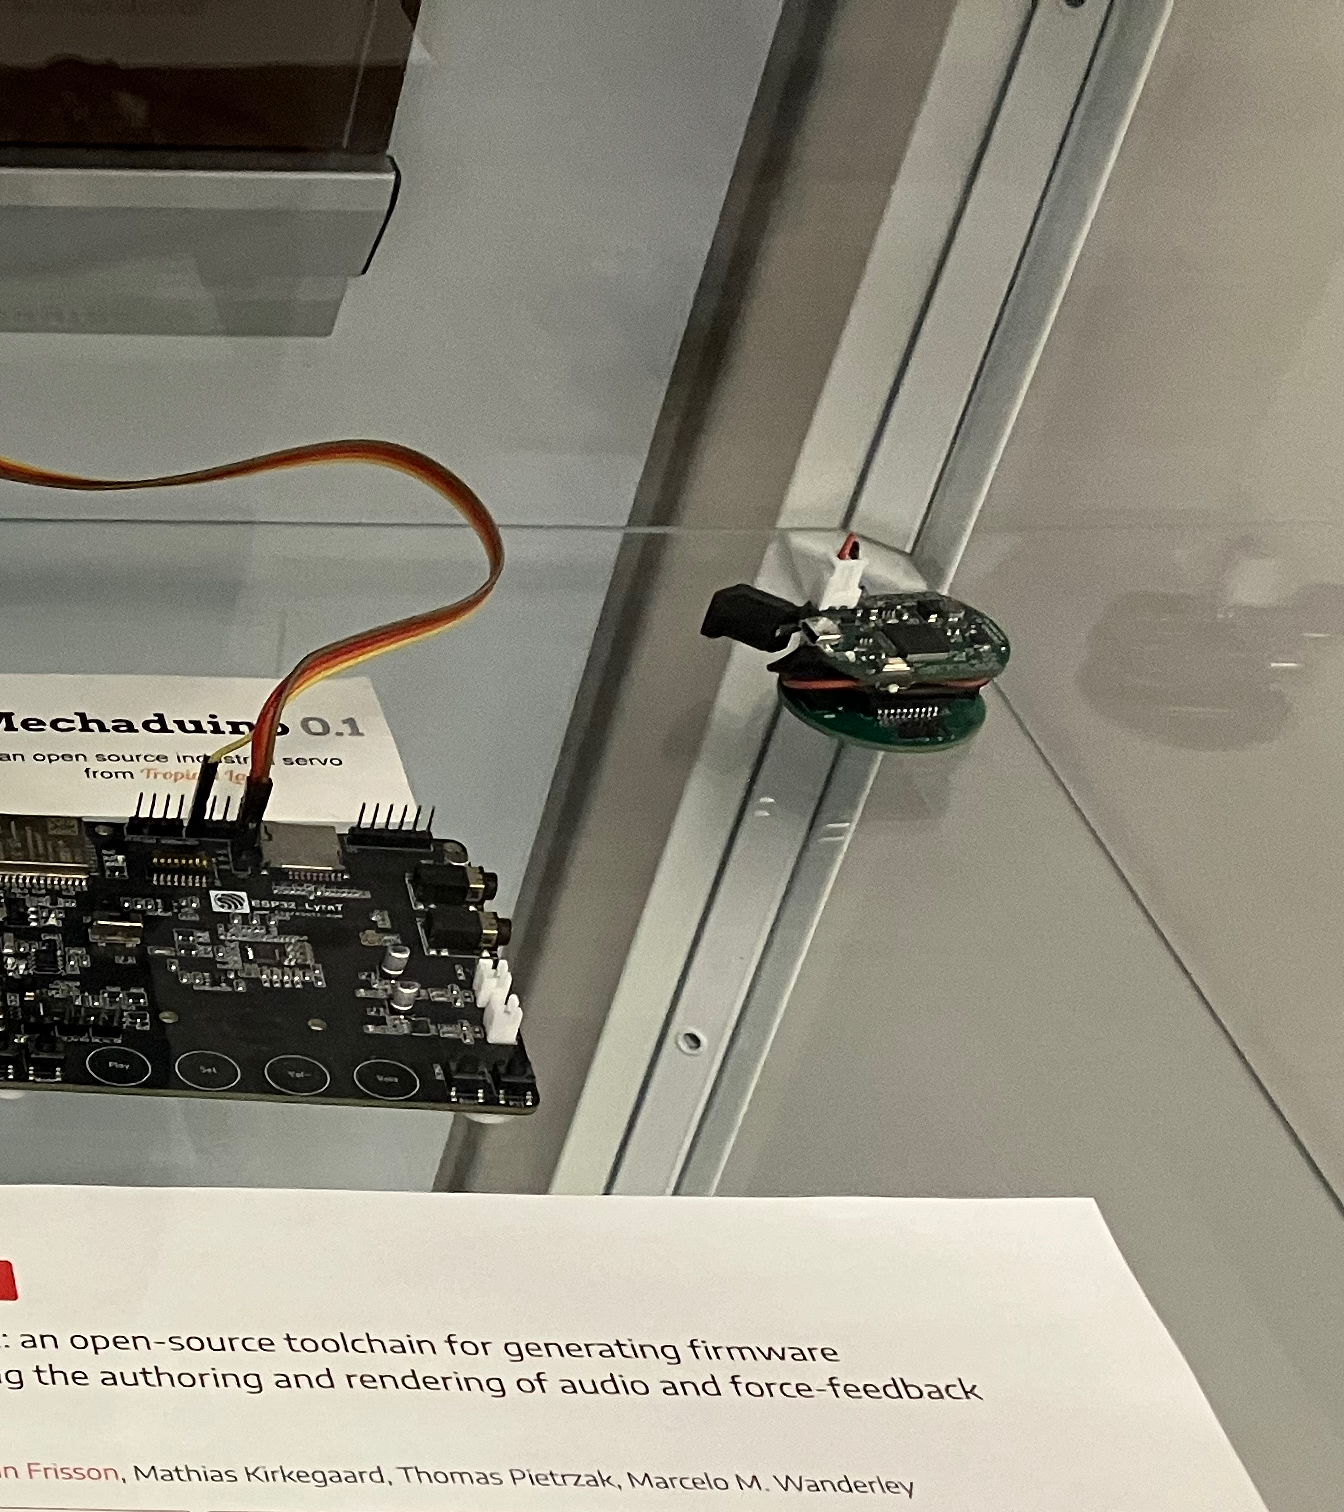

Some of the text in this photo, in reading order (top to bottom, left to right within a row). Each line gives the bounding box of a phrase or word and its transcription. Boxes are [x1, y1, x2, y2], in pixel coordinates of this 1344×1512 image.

[300, 717, 365, 737] 0.1
[0, 750, 25, 763] an
[33, 752, 87, 765] open
[96, 751, 169, 764] source
[283, 755, 343, 767] servo
[85, 768, 134, 780] from
[20, 1332, 58, 1350] an
[70, 1332, 275, 1355] open-source
[283, 1332, 437, 1357] toolchain
[445, 1334, 492, 1357] for
[504, 1338, 682, 1365] generating
[688, 1338, 839, 1363] firmware
[33, 1364, 89, 1386] the
[100, 1367, 263, 1394] authoring
[274, 1367, 334, 1390] and
[345, 1368, 507, 1398] rendering
[516, 1372, 547, 1395] of
[561, 1374, 650, 1397] audio
[661, 1375, 722, 1398] and
[729, 1375, 983, 1401] force-feedback
[26, 1461, 127, 1486] Frisson,
[134, 1464, 238, 1484] Mathias
[245, 1465, 392, 1488] Kirkegaard,
[398, 1466, 503, 1486] Thomas
[510, 1468, 622, 1491] Pietrzak,
[628, 1472, 729, 1492] Marcelo
[736, 1474, 769, 1493] M.
[775, 1474, 914, 1499] Wanderley
